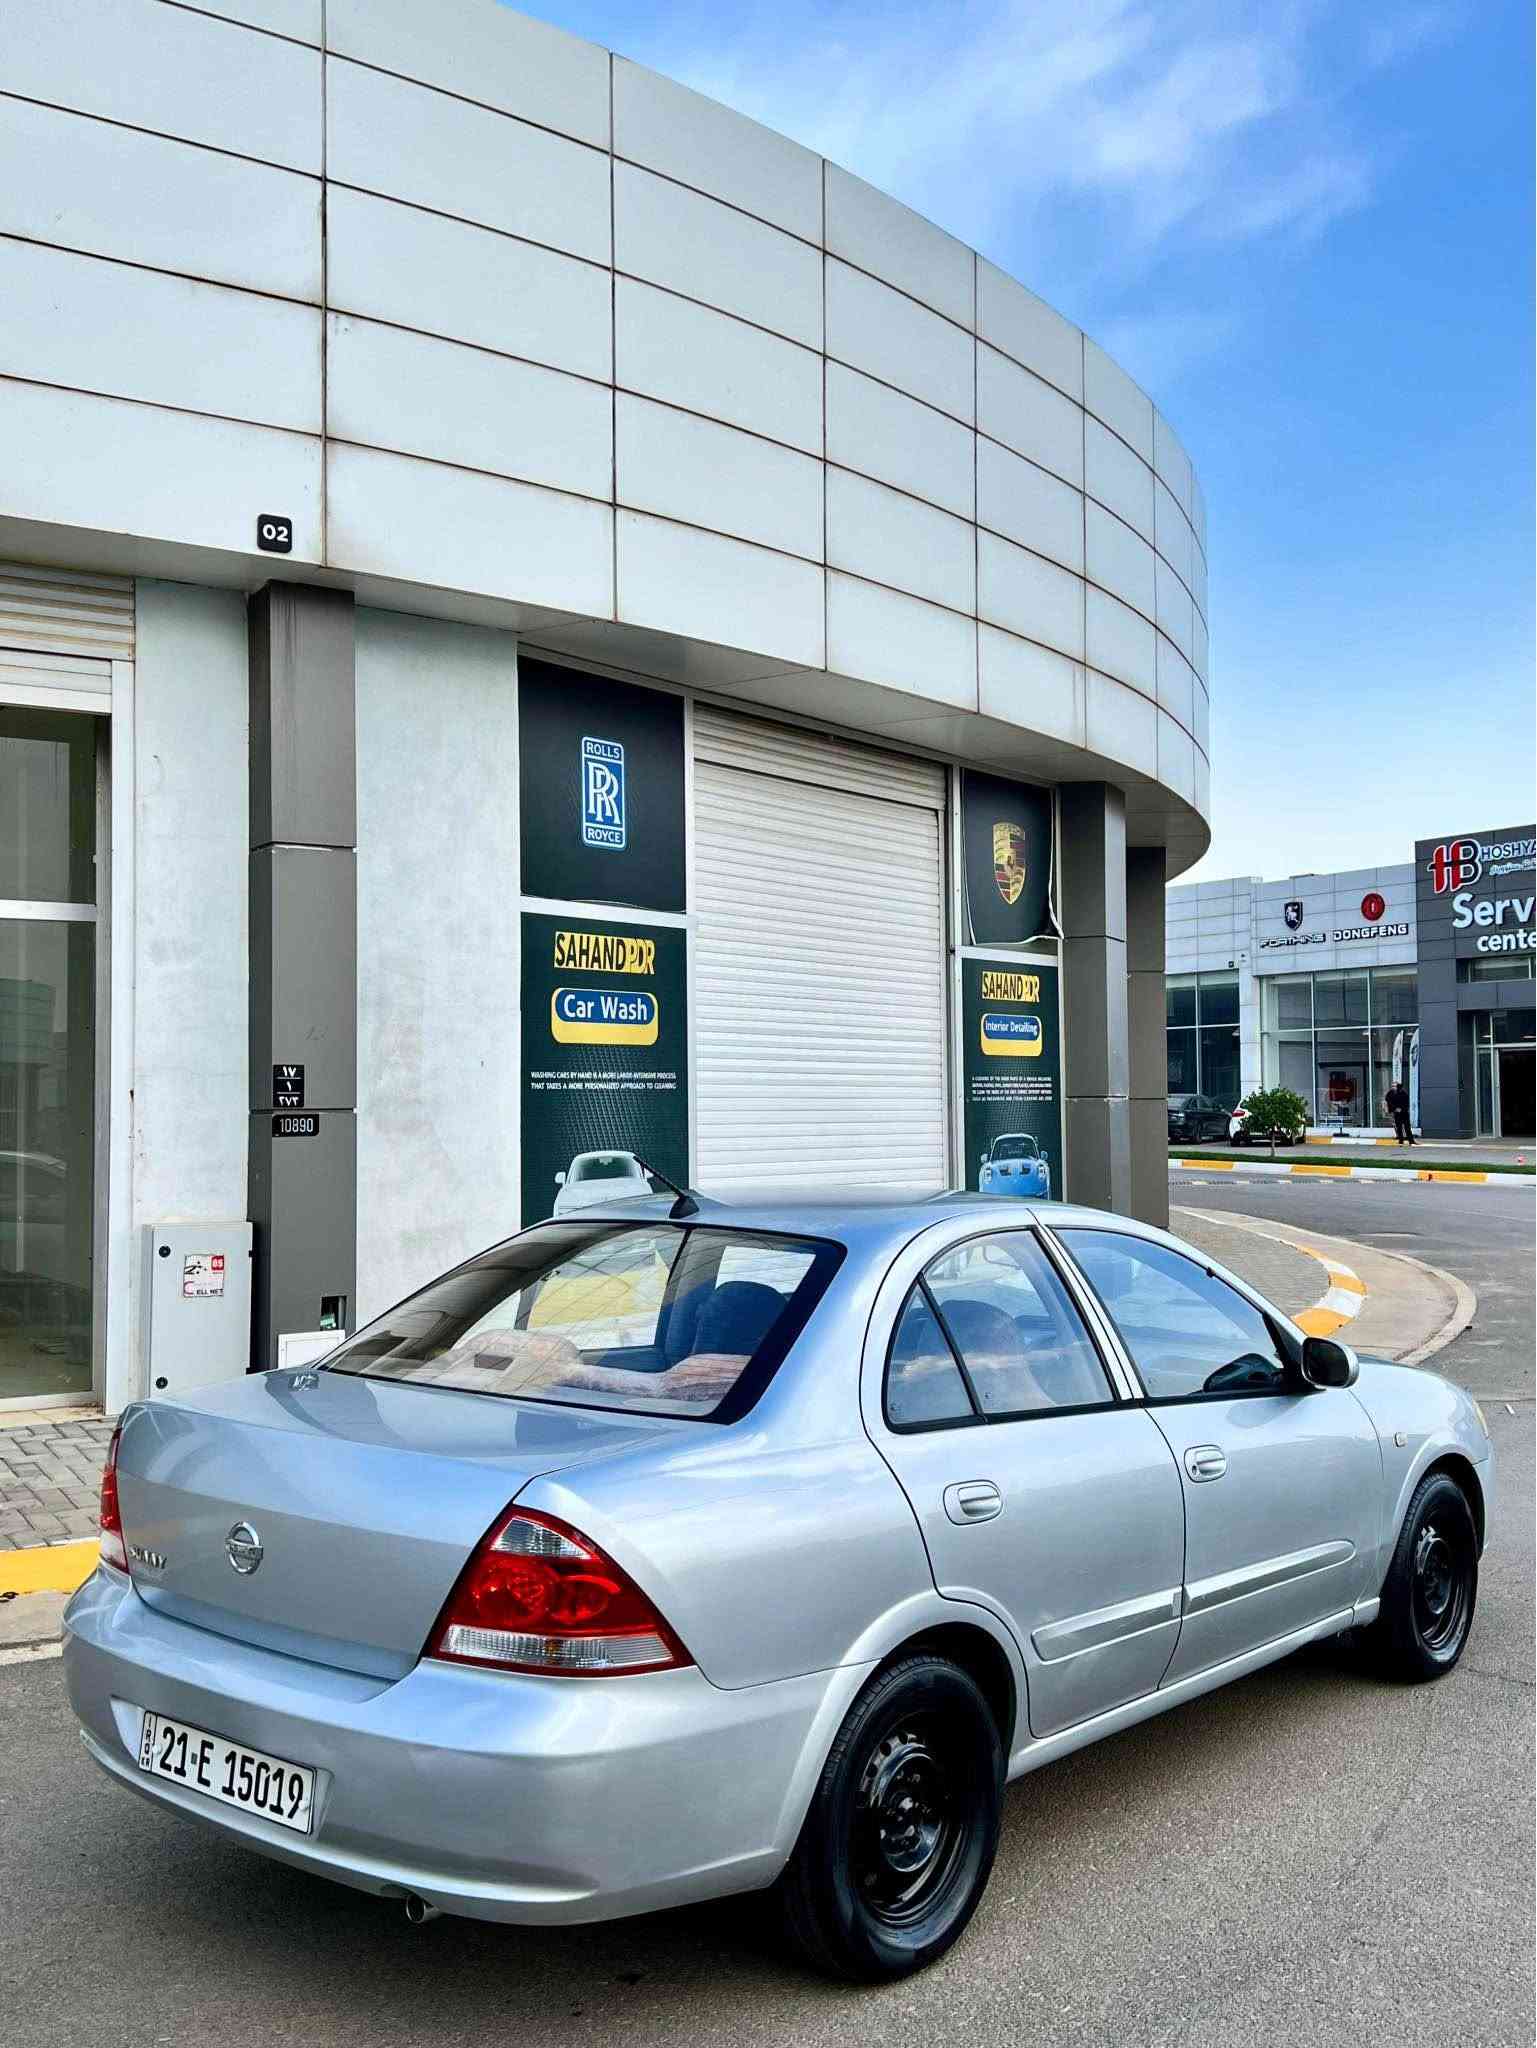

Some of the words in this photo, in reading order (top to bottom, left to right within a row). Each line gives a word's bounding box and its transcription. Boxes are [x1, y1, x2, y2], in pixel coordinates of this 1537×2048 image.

[262, 523, 289, 543] 02
[586, 742, 620, 759] ROLLS
[587, 827, 621, 843] ROYCE
[1452, 892, 1535, 928] Serv
[1260, 933, 1326, 948] FORTHING
[1333, 924, 1408, 942] DONGFENG
[563, 994, 595, 1018] Car
[600, 995, 648, 1021] Wash
[985, 1020, 1009, 1033] Interior
[1010, 1021, 1038, 1037] Detailing
[602, 1071, 616, 1079] MORE
[280, 1118, 313, 1133] 10890
[222, 1750, 304, 1819] 15019
